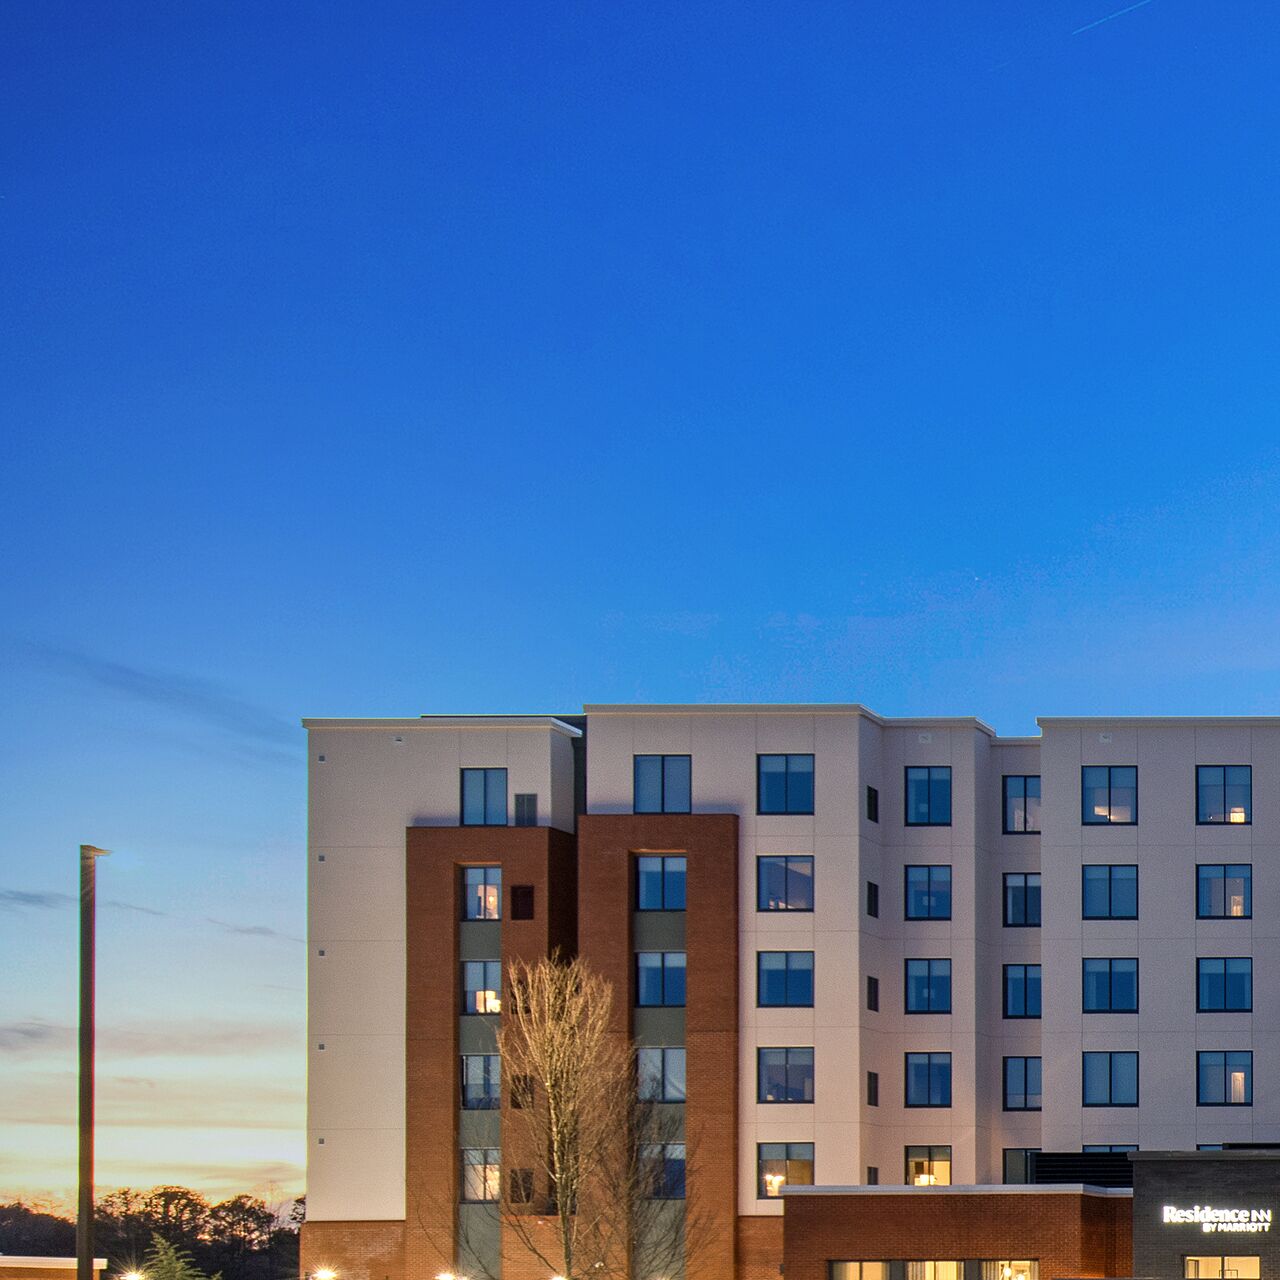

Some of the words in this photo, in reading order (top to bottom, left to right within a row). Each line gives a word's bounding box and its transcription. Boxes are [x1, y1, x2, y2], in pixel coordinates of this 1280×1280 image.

[1163, 1205, 1250, 1223] Residence
[1251, 1209, 1272, 1222] INN
[1202, 1223, 1217, 1233] BY
[1218, 1223, 1271, 1232] MARRIOTT
